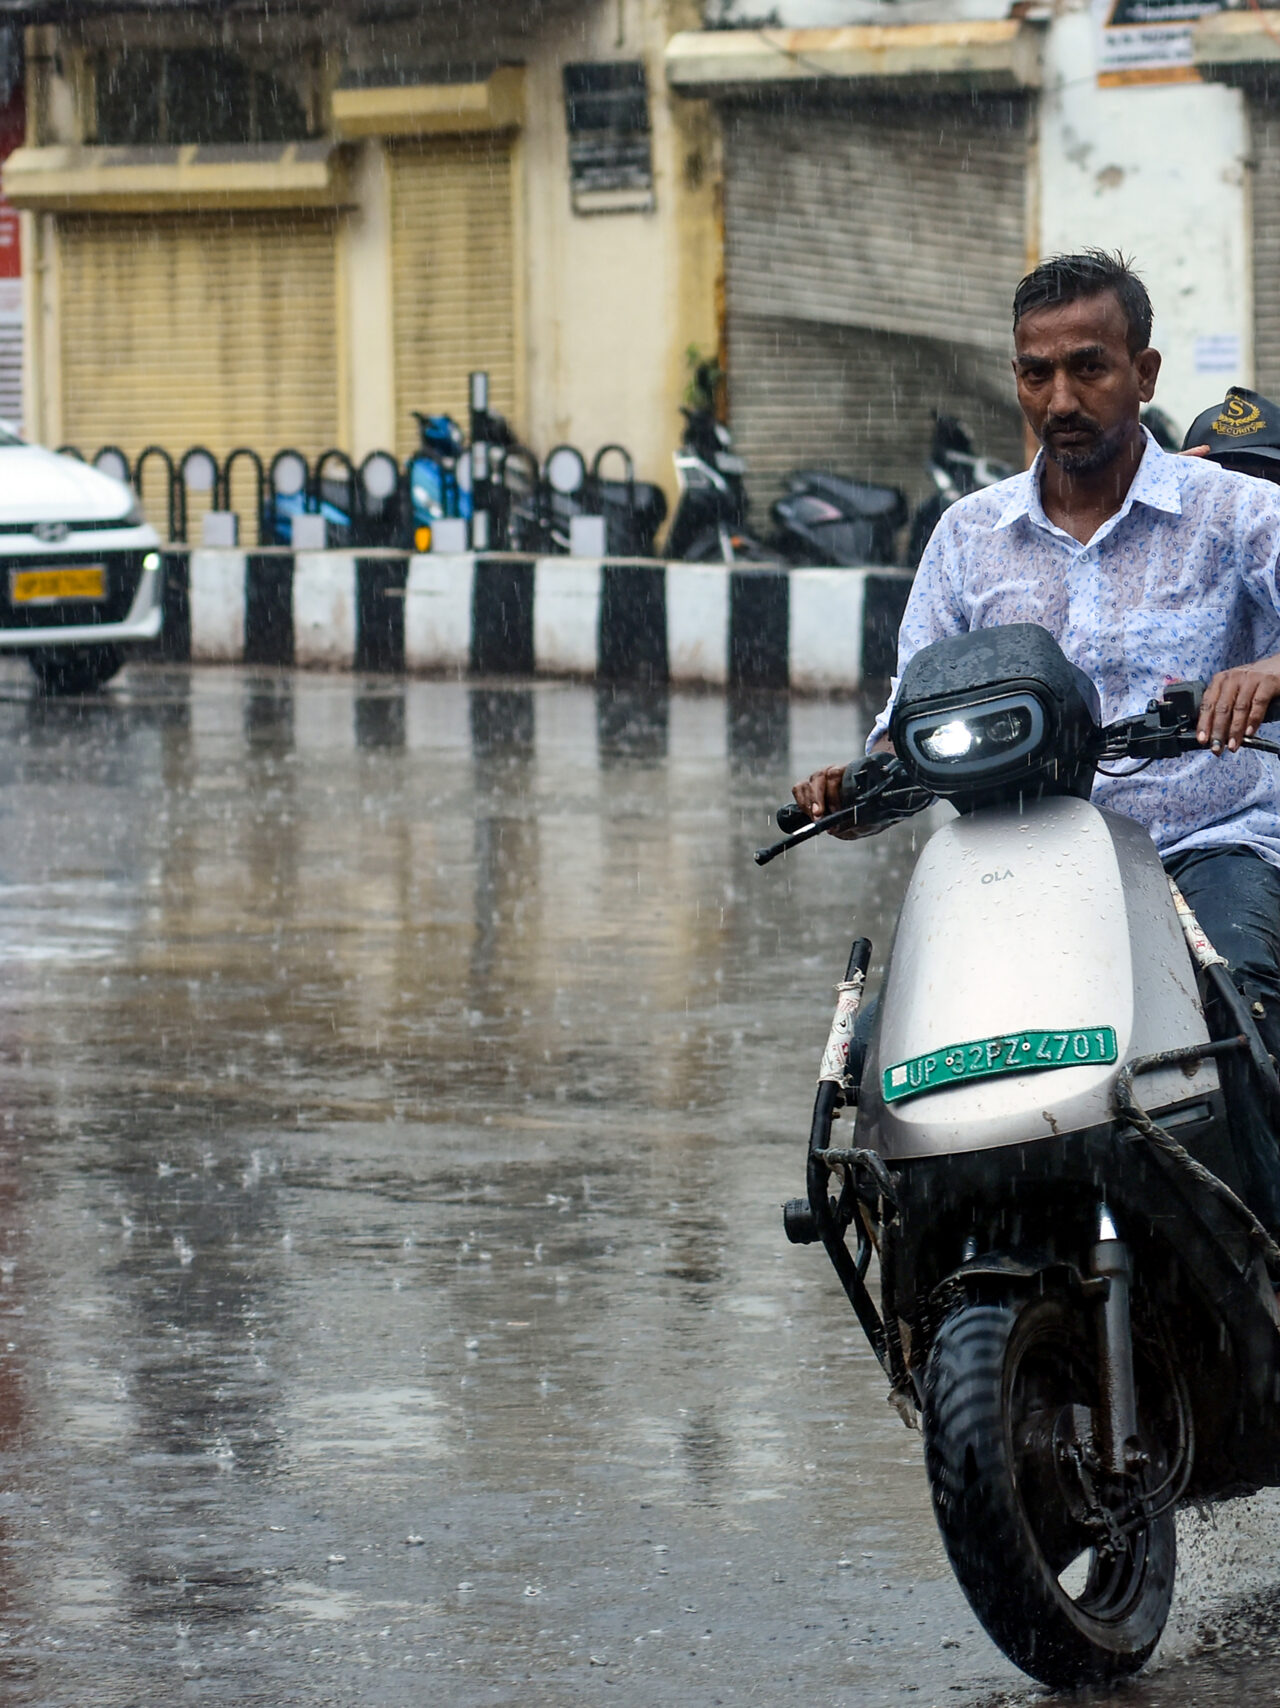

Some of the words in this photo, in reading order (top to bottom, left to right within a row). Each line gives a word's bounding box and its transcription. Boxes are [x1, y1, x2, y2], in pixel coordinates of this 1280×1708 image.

[1228, 400, 1244, 417] S
[980, 869, 1015, 884] OLA
[909, 1057, 937, 1088] UP
[949, 1038, 1021, 1075] 32PZ
[1036, 1032, 1107, 1062] 4701
